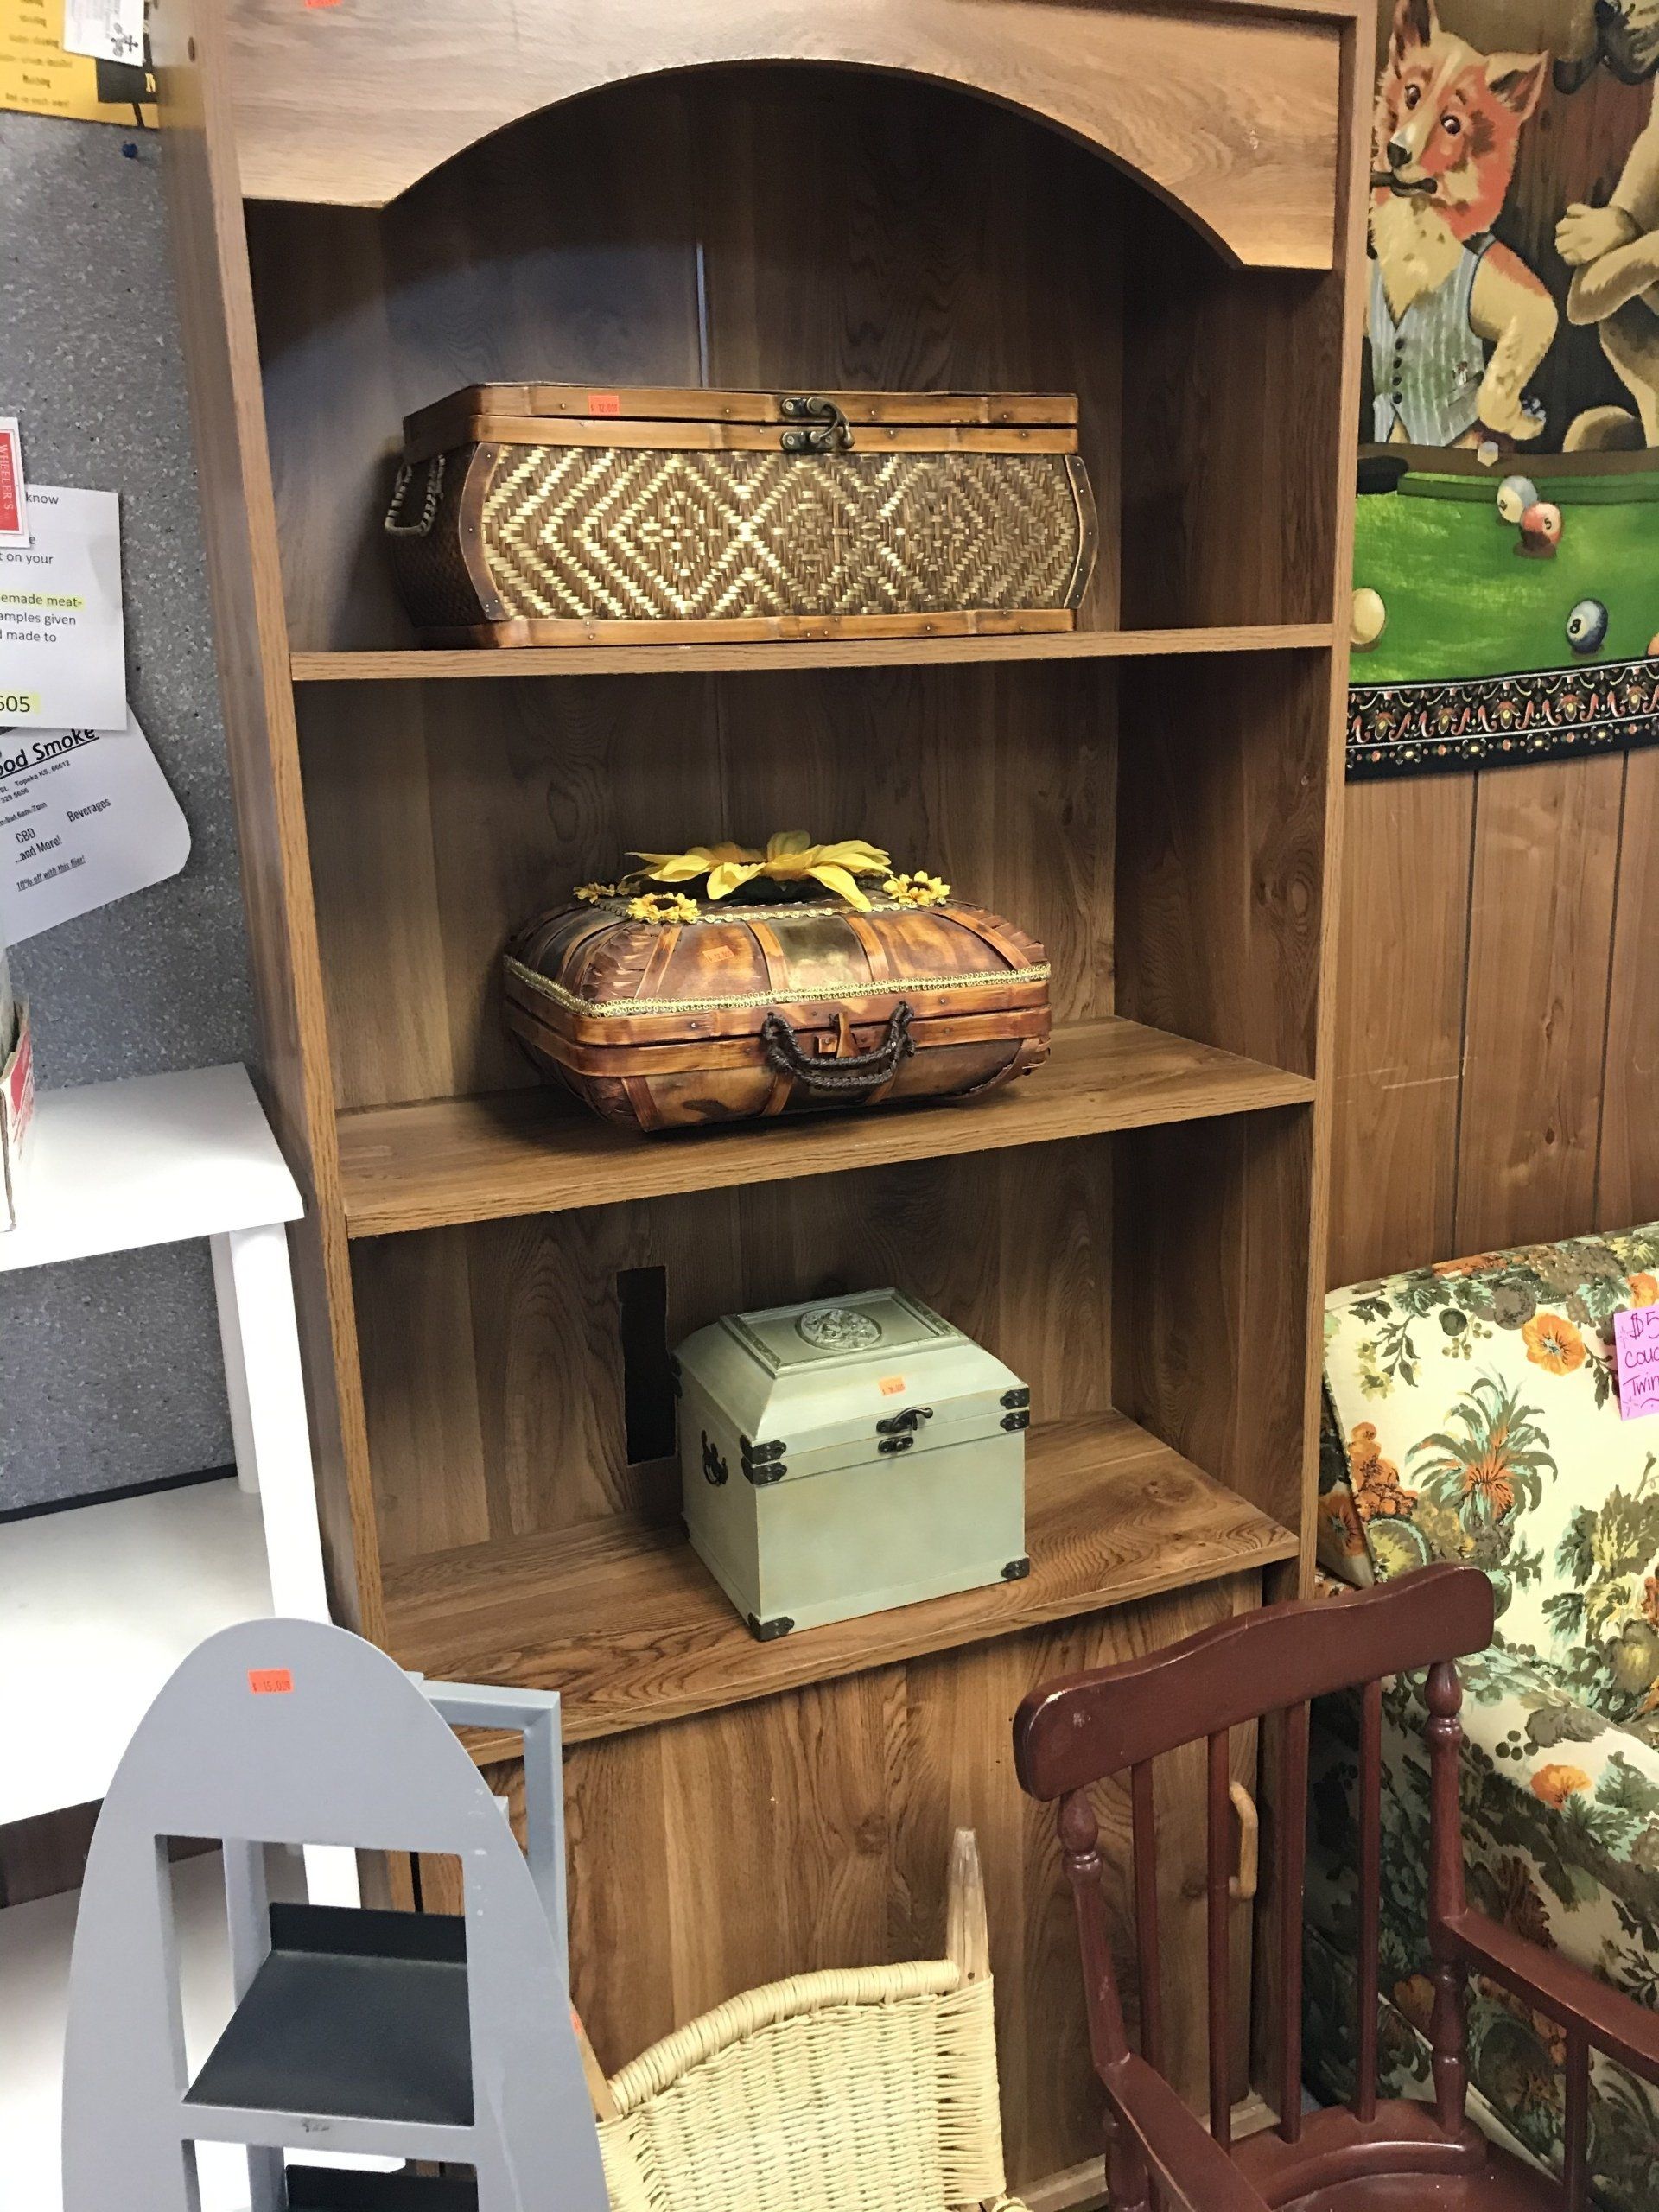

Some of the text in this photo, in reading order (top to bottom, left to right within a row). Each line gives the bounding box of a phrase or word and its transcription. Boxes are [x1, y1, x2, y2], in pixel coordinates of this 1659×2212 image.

[25, 492, 59, 505] know
[1544, 517, 1553, 530] 5
[6, 553, 22, 563] on
[26, 556, 54, 565] your
[1, 594, 82, 607] emade meat-
[45, 613, 76, 626] given
[1569, 619, 1581, 634] 8
[6, 630, 41, 642] made
[44, 632, 57, 643] to
[32, 728, 96, 760] Smoke
[15, 773, 39, 787] Topeka
[67, 798, 111, 823] Beverages
[15, 827, 36, 844] CBD
[35, 834, 63, 854] More!
[16, 877, 34, 892] 10%
[33, 872, 43, 885] off
[43, 867, 57, 880] with
[57, 862, 69, 874] this
